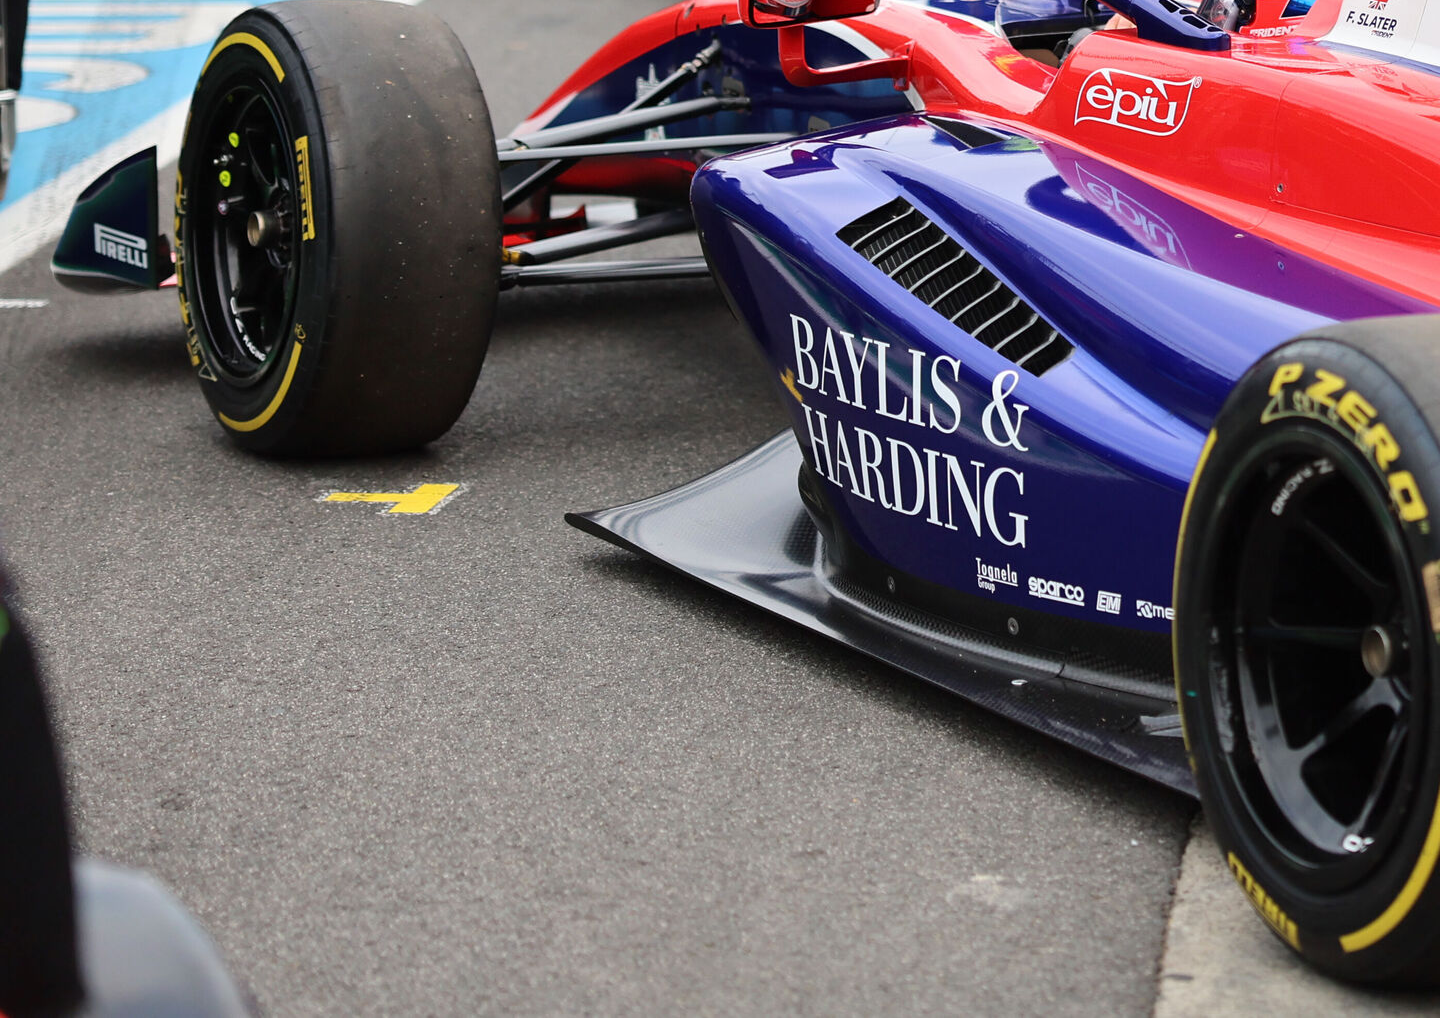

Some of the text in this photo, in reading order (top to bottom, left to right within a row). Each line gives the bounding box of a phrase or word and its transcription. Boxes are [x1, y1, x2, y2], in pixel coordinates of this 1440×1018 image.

[1346, 10, 1398, 32] F. SLATER
[1370, 29, 1394, 39] TRIDENT
[94, 224, 149, 270] PIRELLI
[789, 314, 1029, 452] BAYLIS &
[1269, 362, 1304, 397] P
[1305, 368, 1429, 522] ZERO
[801, 402, 1029, 549] HARDING
[975, 557, 1019, 584] Tognela
[977, 576, 996, 594] Group
[1028, 576, 1086, 604] sparco
